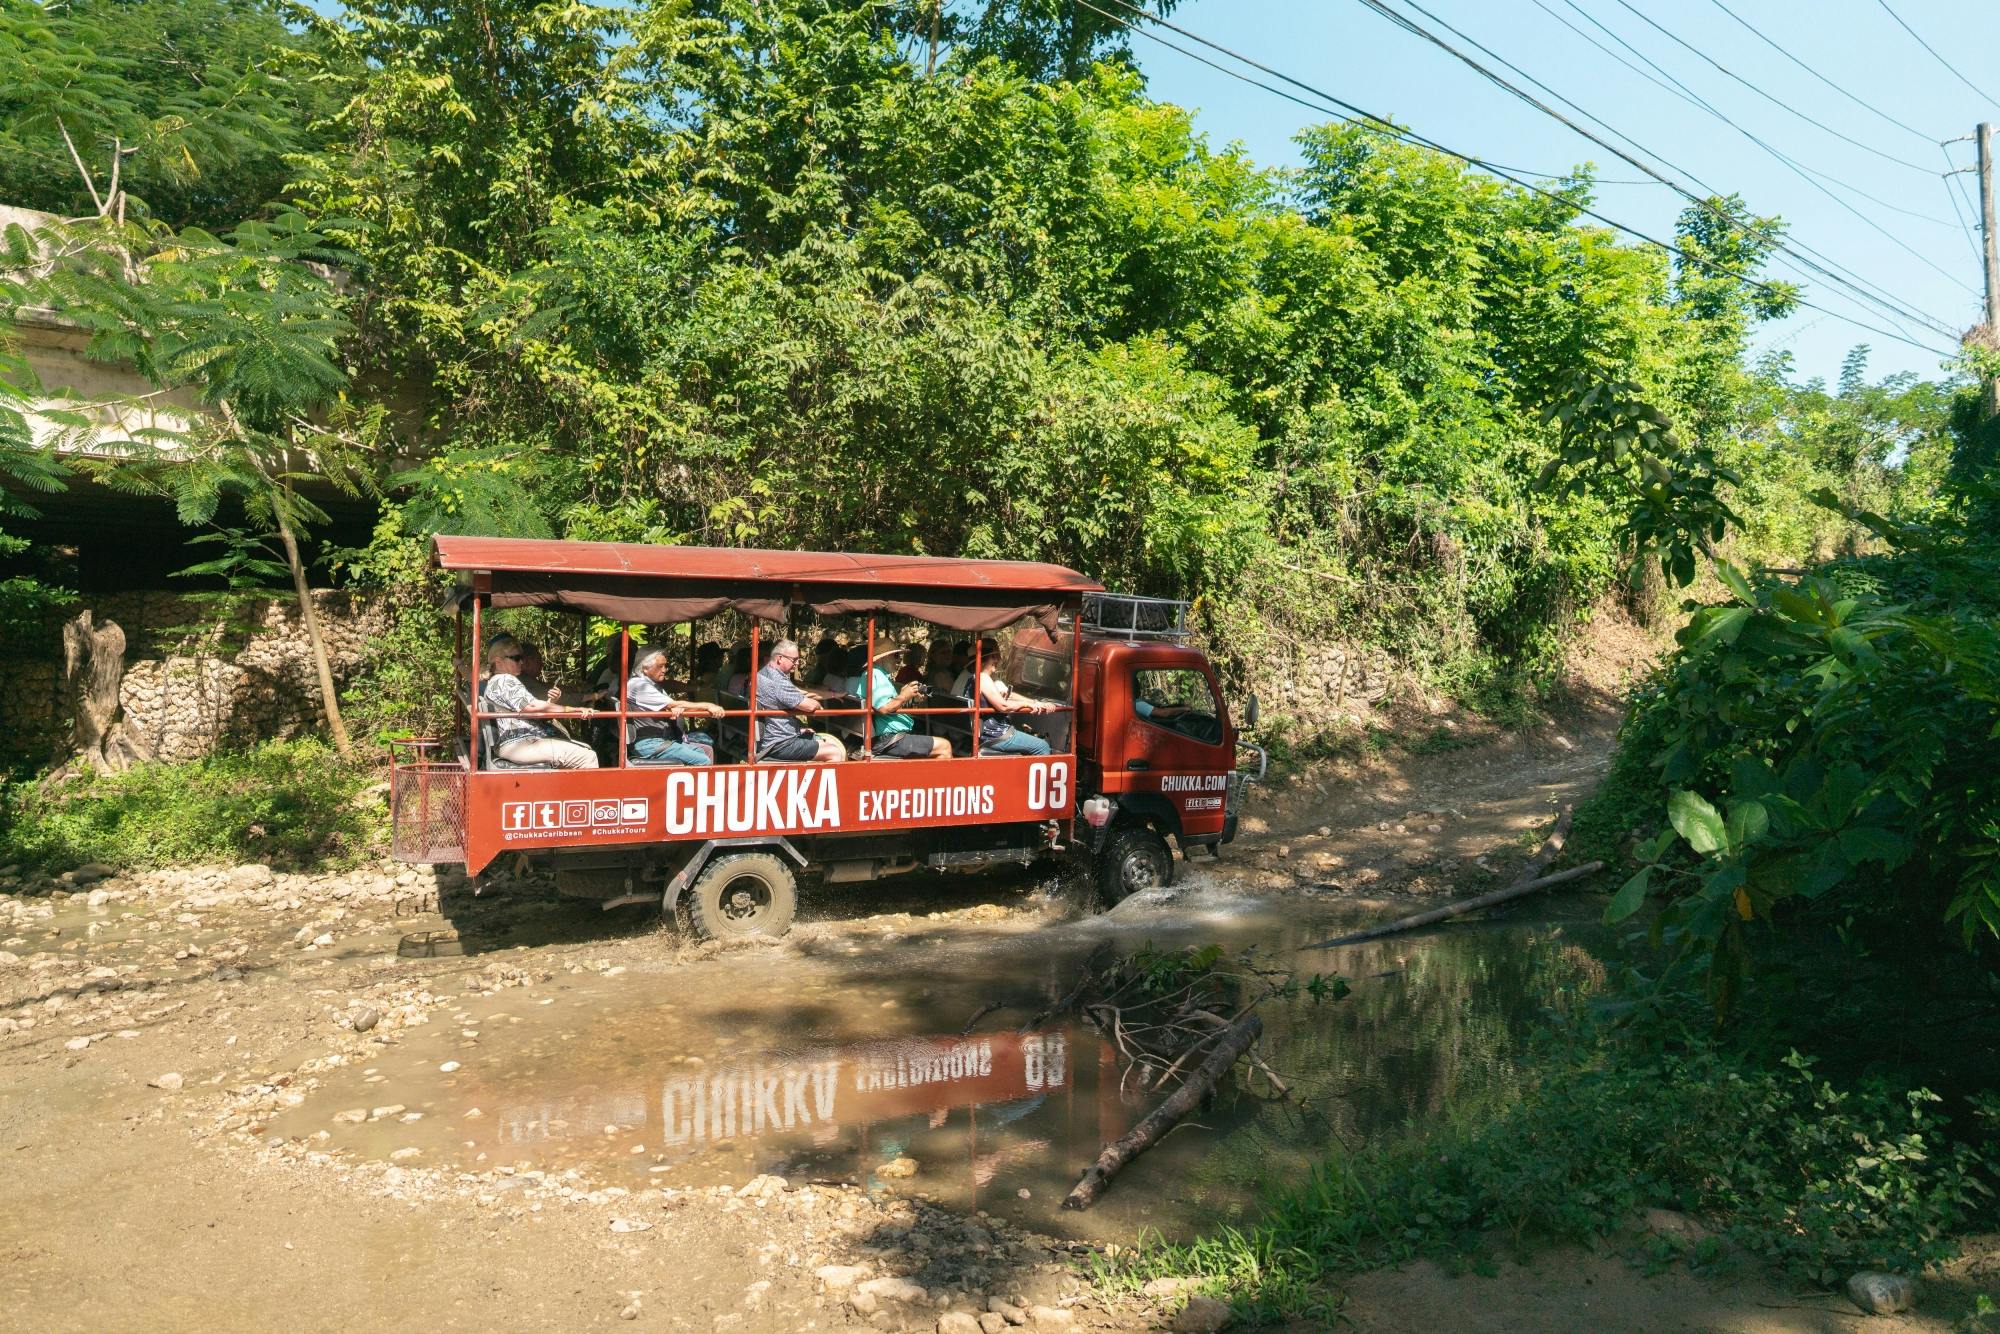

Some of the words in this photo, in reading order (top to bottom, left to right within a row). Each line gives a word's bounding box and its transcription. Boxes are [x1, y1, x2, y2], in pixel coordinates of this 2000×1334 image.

[1162, 775, 1226, 791] CHUKKA.COM
[666, 769, 840, 835] CHUKKA
[859, 785, 994, 821] EXPEDITIONS
[1028, 762, 1068, 810] 03
[505, 830, 582, 840] @ChukkaCaribbean
[592, 827, 646, 835] #ChukkaTours
